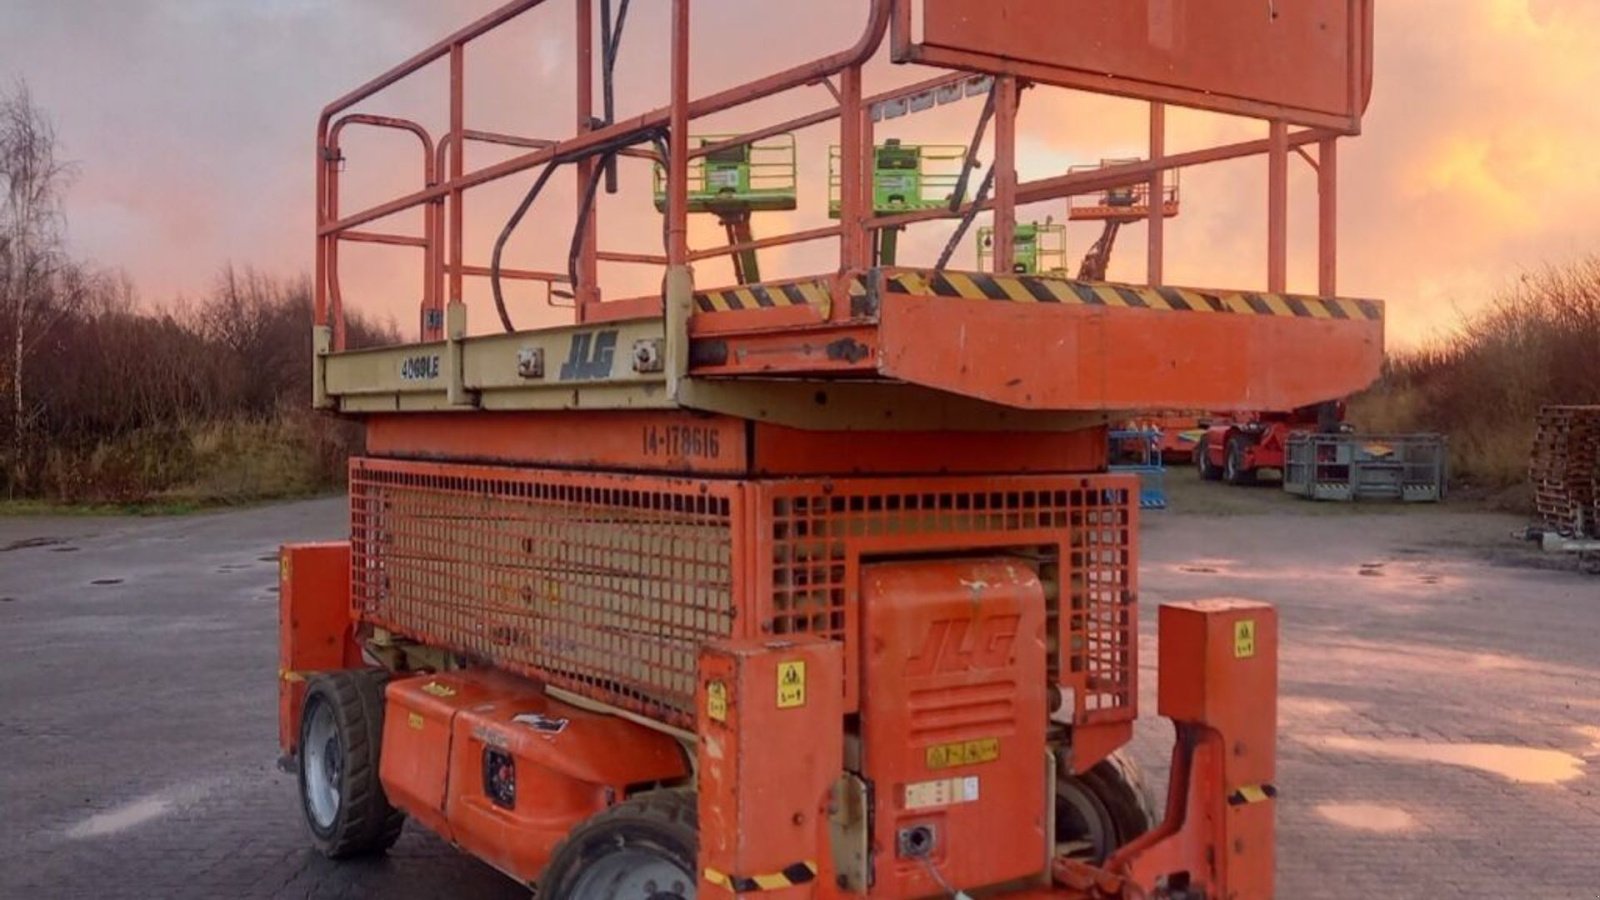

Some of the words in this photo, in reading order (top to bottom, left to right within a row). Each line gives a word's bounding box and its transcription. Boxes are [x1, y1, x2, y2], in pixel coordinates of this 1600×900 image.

[559, 330, 619, 380] JLG
[642, 425, 719, 459] 14-178616
[901, 614, 1018, 677] JLG
